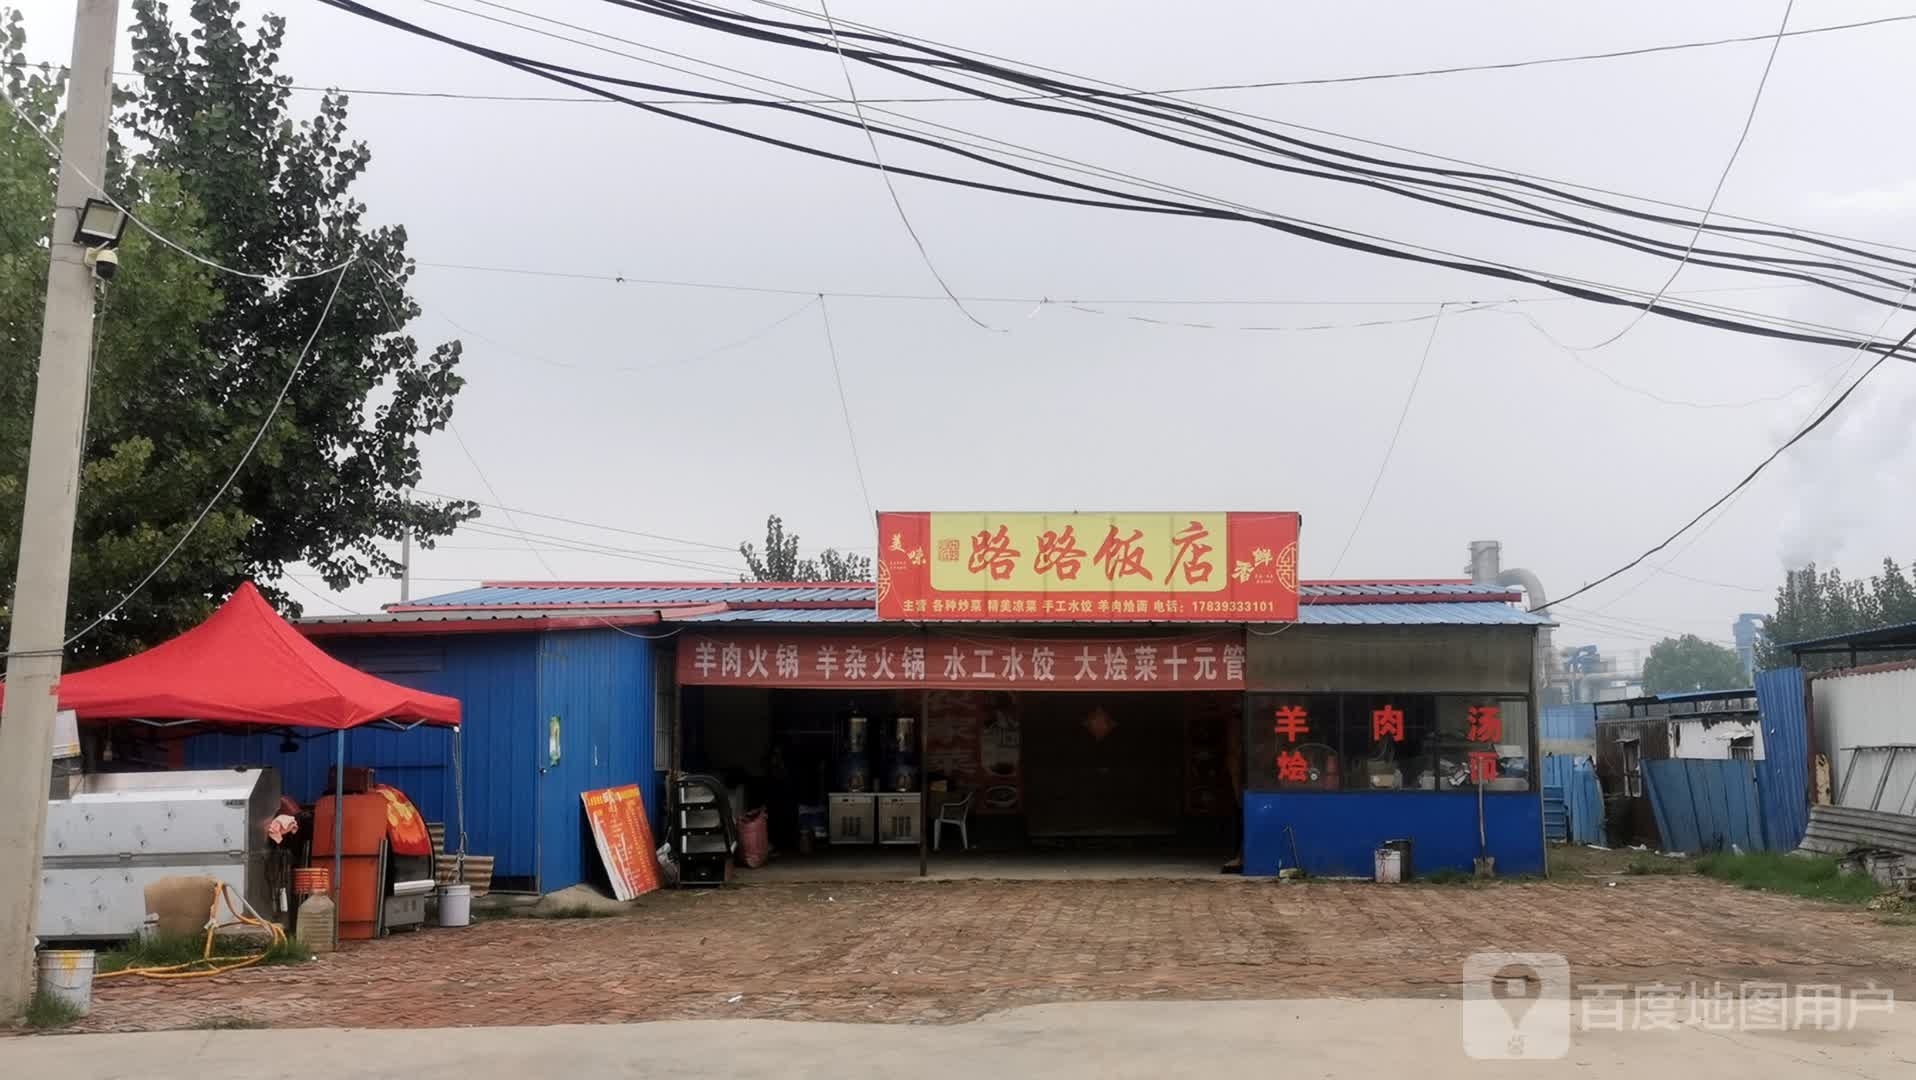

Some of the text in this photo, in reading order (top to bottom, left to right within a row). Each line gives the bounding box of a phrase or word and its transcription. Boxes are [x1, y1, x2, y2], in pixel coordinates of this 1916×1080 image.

[888, 532, 927, 566] 美味
[967, 520, 1213, 586] 路路饭店
[903, 600, 927, 613] 主营
[933, 600, 982, 613] 各种炒菜
[987, 600, 1037, 613] 精美凉菜
[1042, 600, 1093, 613] 手工水饺
[1098, 600, 1149, 613] 羊肉烩面
[1192, 601, 1274, 612] 17839333101
[694, 643, 1246, 682] 羊肉火锅 羊杂火锅 水工水饺 大烩菜十元管
